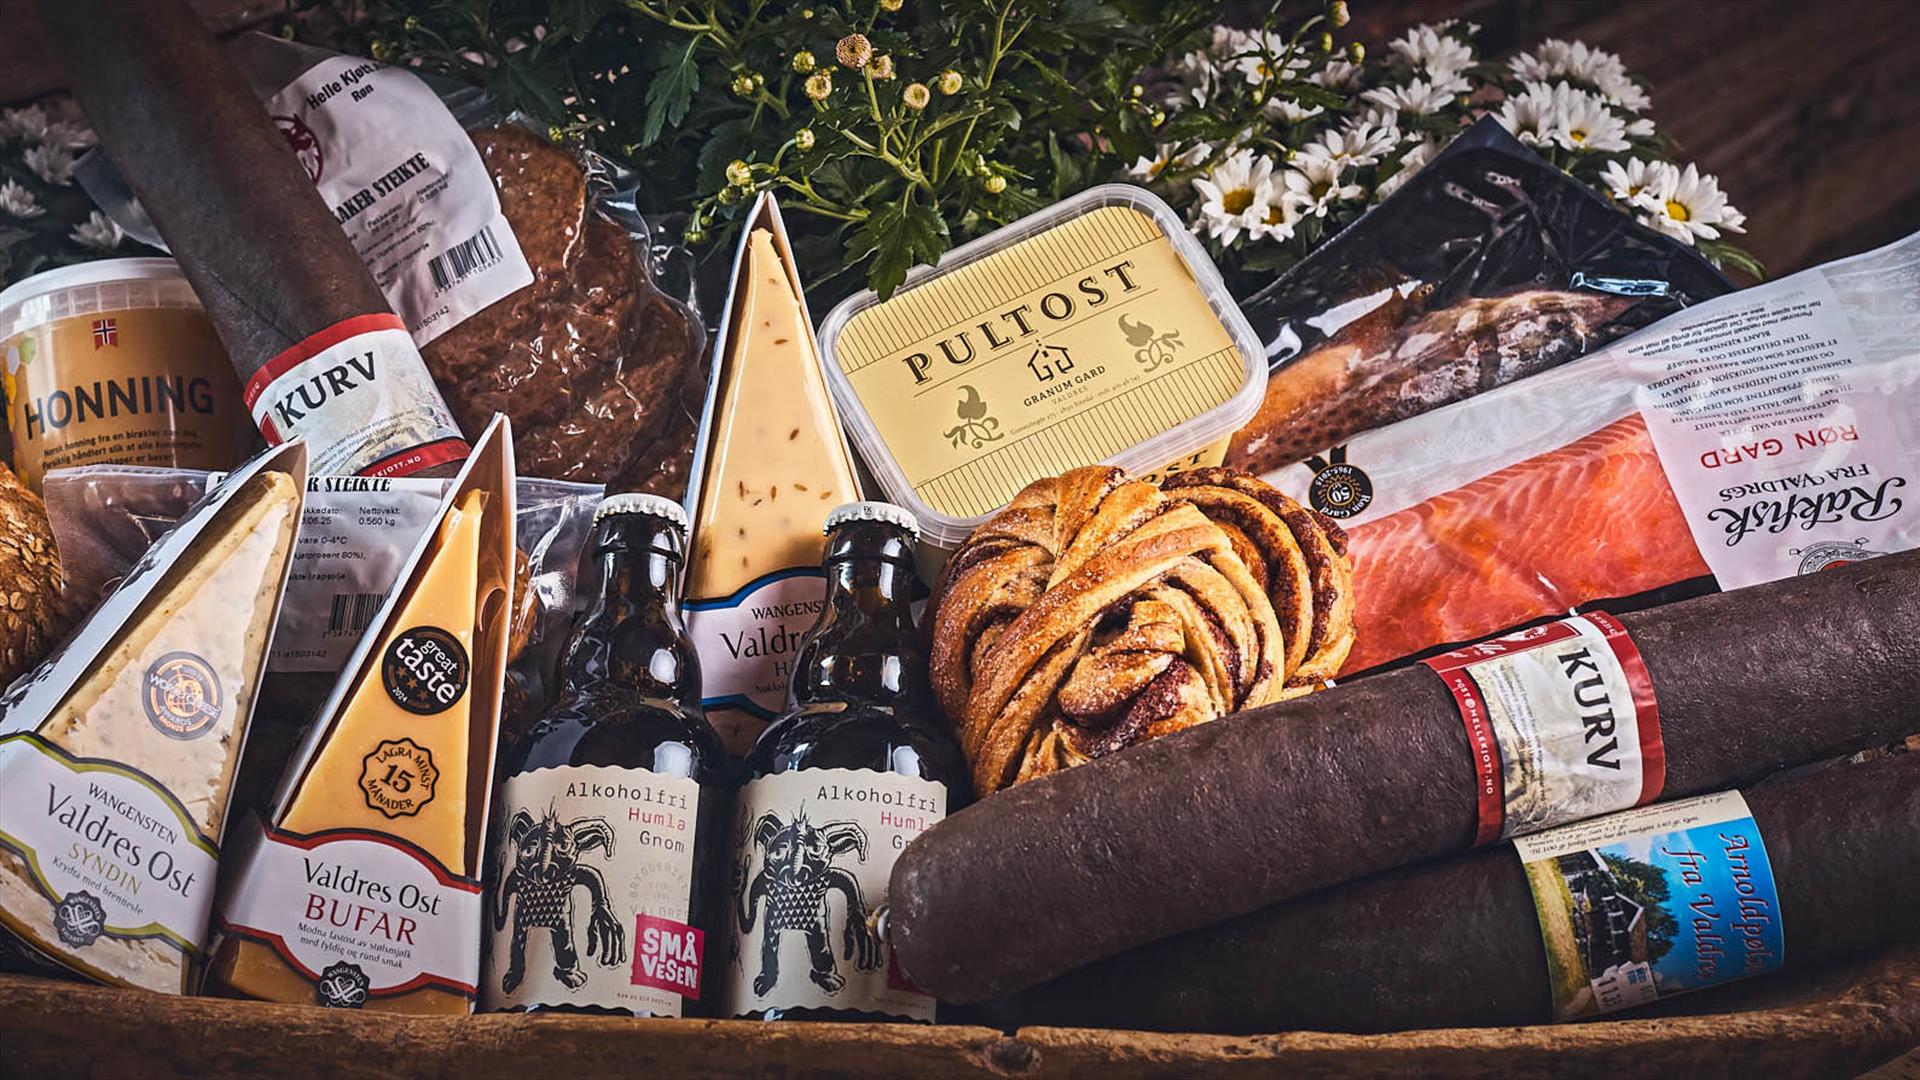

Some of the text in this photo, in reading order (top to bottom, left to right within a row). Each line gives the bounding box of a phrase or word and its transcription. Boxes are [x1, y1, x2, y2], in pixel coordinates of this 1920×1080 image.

[307, 81, 342, 110] Helle
[351, 83, 374, 102] Røn
[372, 152, 430, 197] STEIKTE
[902, 260, 1141, 386] PULTOST
[1743, 330, 1770, 341] BLANT
[1786, 342, 1823, 355] RESULTAT
[1823, 338, 1837, 347] ET
[1647, 373, 1685, 390] VALDRES
[1685, 367, 1702, 375] FRA
[1778, 369, 1799, 378] MED
[275, 351, 376, 429] KURV
[1023, 365, 1106, 407] GRANUM GARD
[24, 376, 214, 440] HONNING
[1703, 401, 1721, 411] DEN
[1723, 397, 1743, 405] SOM
[64, 437, 95, 449] honning
[97, 434, 110, 442] fra
[126, 443, 134, 451] at
[1700, 424, 1859, 470] RØN GARD
[325, 477, 392, 492] STEIKTE
[1314, 466, 1352, 486] 1965-2015
[1719, 463, 1870, 503] FRA VALDRES
[1320, 493, 1371, 519] Røn Gard
[1332, 486, 1350, 503] 50
[385, 517, 395, 527] kg
[1707, 476, 1906, 547] Rakfisk
[394, 637, 456, 705] taste
[419, 638, 458, 676] great
[392, 686, 408, 703] 2024
[1558, 647, 1621, 771] KURV
[1454, 678, 1494, 795] POST@HELLEKJOTT.NO
[375, 745, 431, 790] LAGRA MINST
[379, 764, 415, 793] 15
[566, 783, 687, 810] Alkoholfri
[817, 785, 937, 813] Alkoholfri
[88, 781, 179, 845] WANGENSTEN
[628, 807, 687, 831] Humla
[46, 783, 196, 897] Valdres Ost
[640, 831, 685, 854] Gnom
[69, 843, 142, 896] SYNDIN
[1663, 847, 1707, 888] fra
[51, 857, 145, 915] Krydra med brennesle
[303, 857, 441, 917] Valdres Ost
[298, 922, 326, 936] Modna
[329, 931, 355, 944] fastost
[305, 893, 417, 945] BUFAR
[300, 936, 402, 968] med fyldig og rund smak
[643, 927, 698, 965] SMÅ
